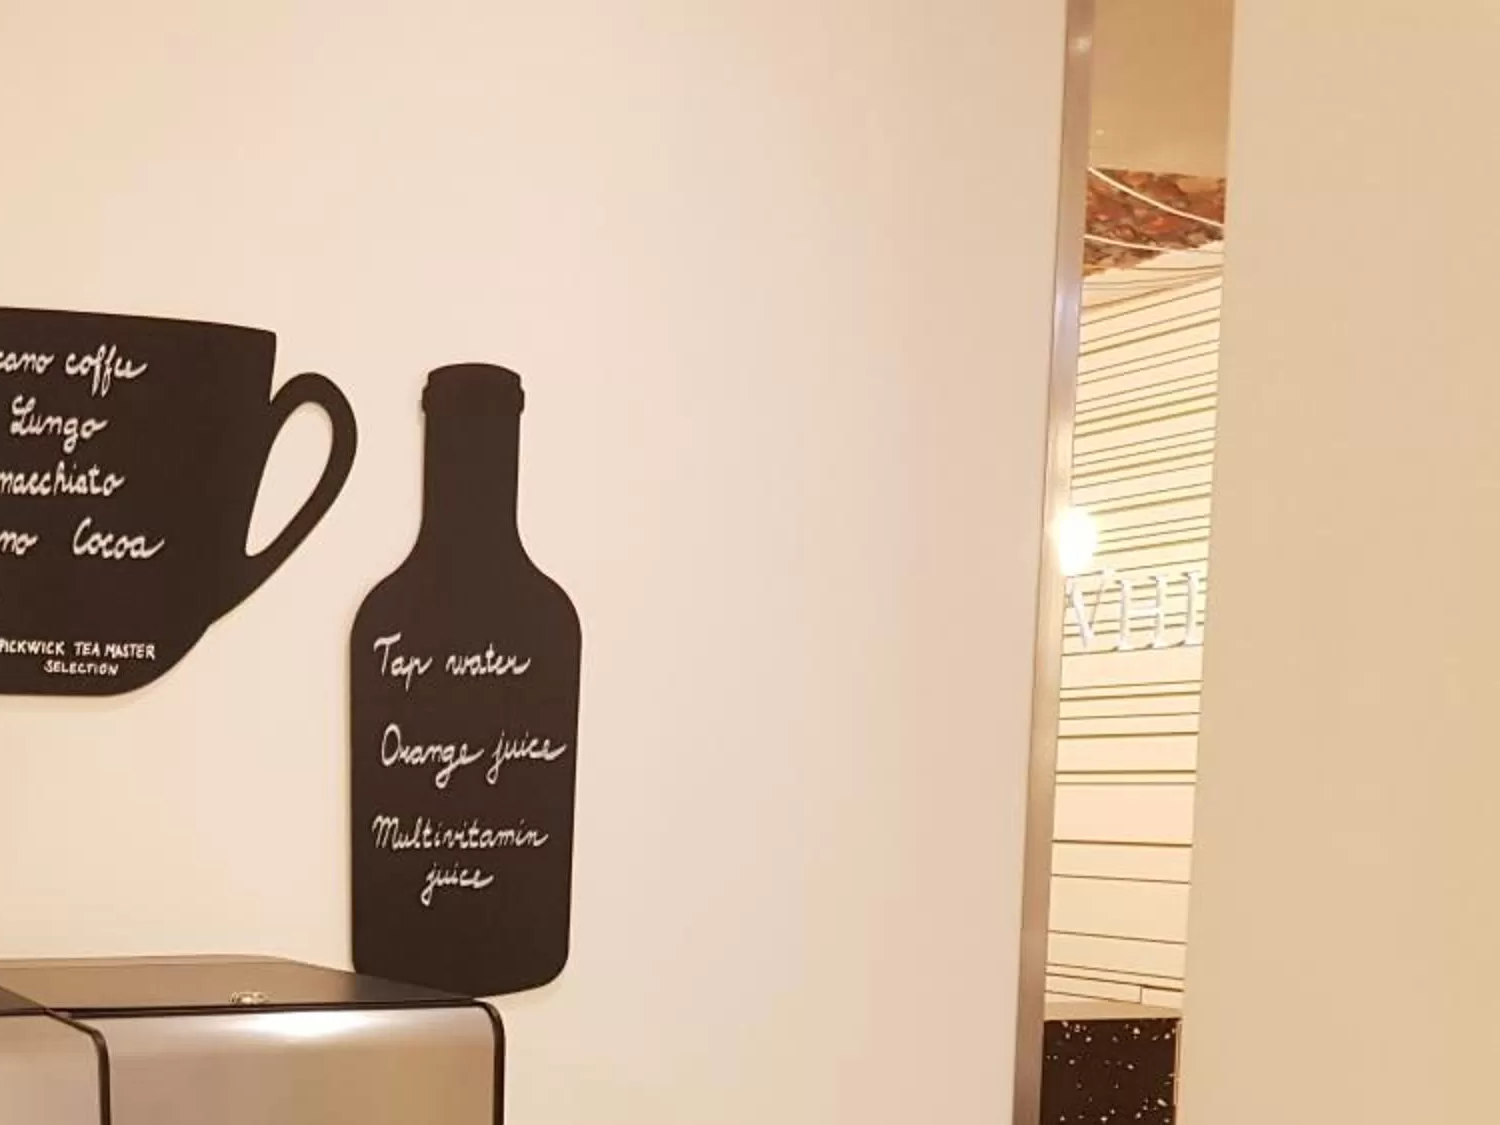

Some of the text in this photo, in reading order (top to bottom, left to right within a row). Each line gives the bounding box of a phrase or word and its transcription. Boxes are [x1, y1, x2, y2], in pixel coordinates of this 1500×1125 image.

[10, 394, 109, 454] Lungo
[72, 516, 165, 560] Cocoa
[43, 659, 119, 677] SELECTION
[73, 641, 101, 657] TEA
[103, 643, 156, 660] MASTER
[373, 632, 531, 693] Tap water
[381, 723, 567, 789] Orange juice
[371, 814, 549, 850] Multivitamin
[420, 861, 494, 907] juice
